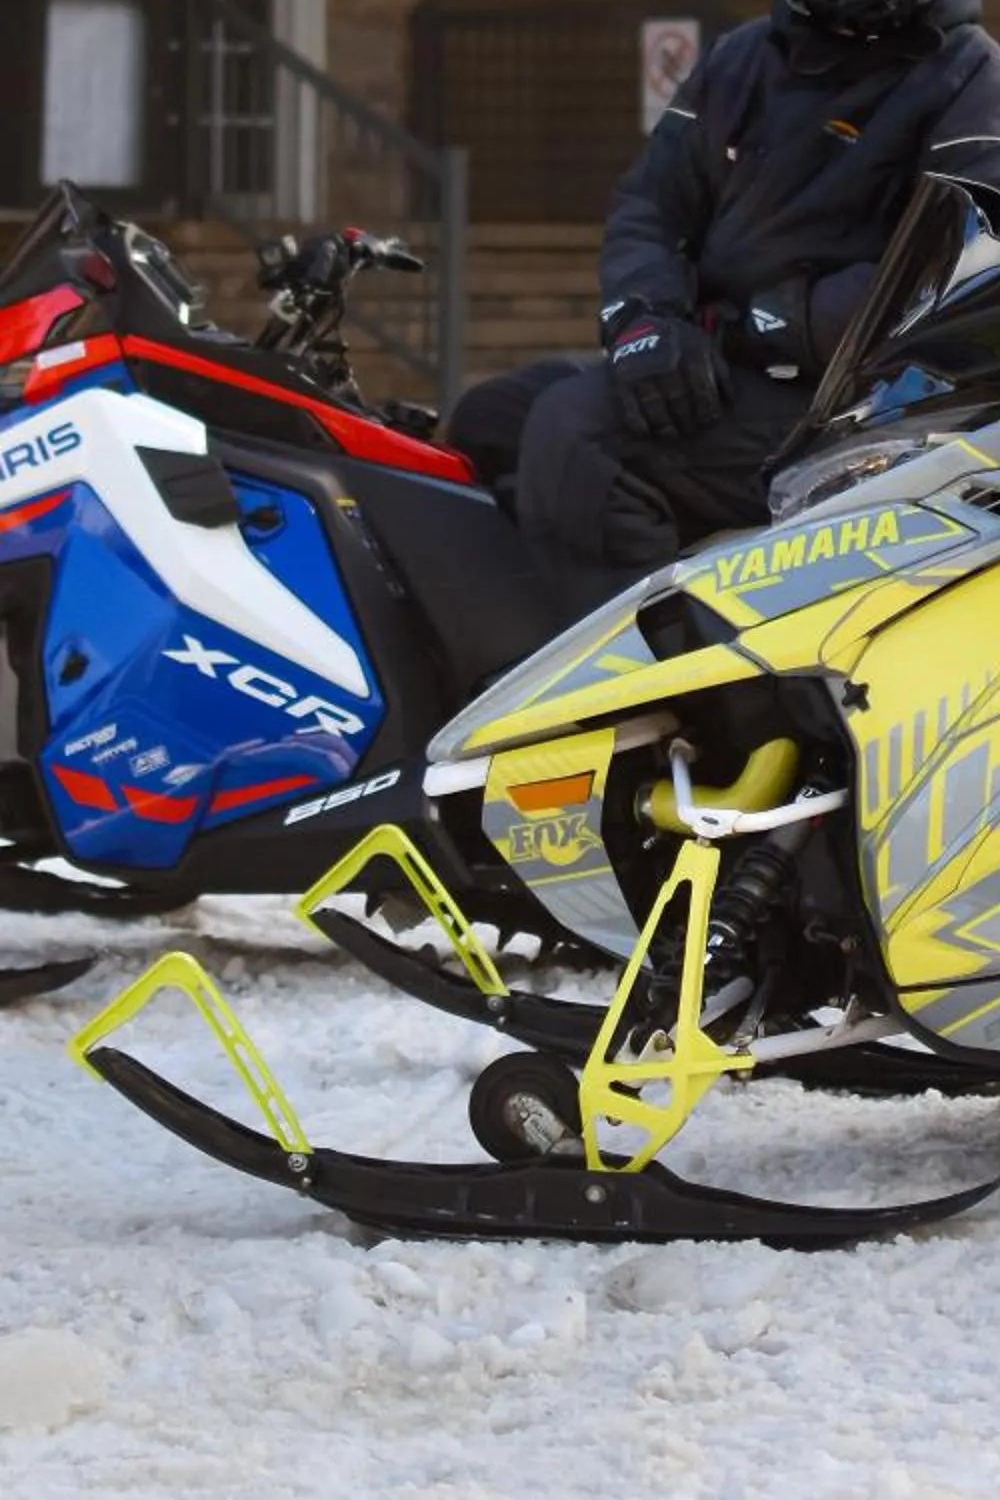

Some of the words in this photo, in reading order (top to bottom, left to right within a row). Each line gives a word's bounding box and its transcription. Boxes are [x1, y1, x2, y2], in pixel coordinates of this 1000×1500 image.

[0, 421, 82, 481] RIS
[715, 510, 899, 588] YAMAHA
[161, 634, 365, 737] XCR
[509, 813, 602, 867] FOX
